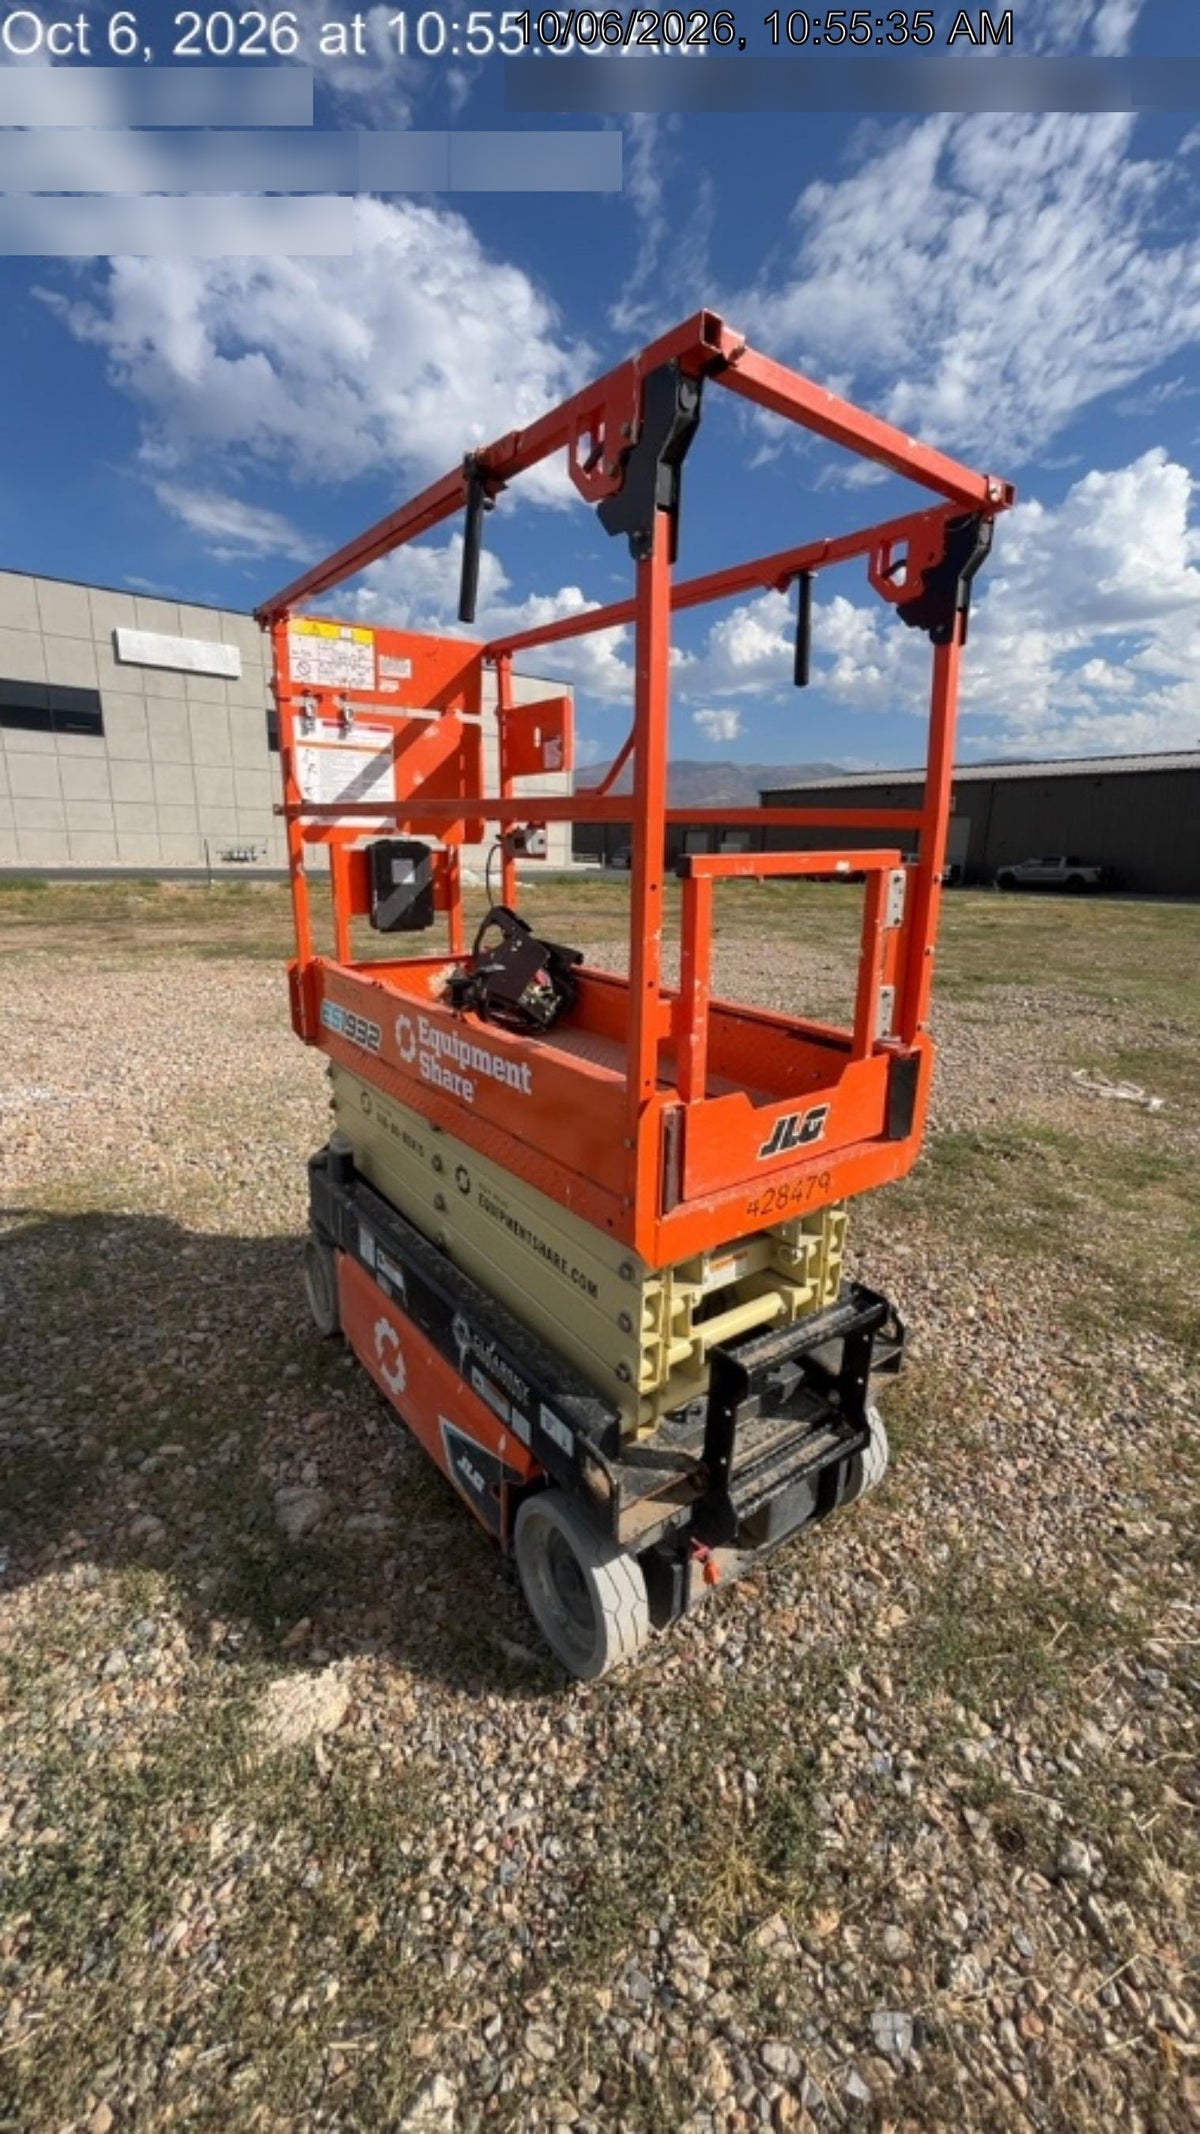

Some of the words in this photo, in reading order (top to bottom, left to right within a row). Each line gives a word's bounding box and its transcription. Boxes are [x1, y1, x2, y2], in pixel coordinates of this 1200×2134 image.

[322, 1000, 381, 1053] ES1932
[417, 1015, 532, 1096] Equipment
[420, 1050, 475, 1103] Share
[757, 1103, 830, 1160] JLG
[746, 1171, 831, 1216] 428479
